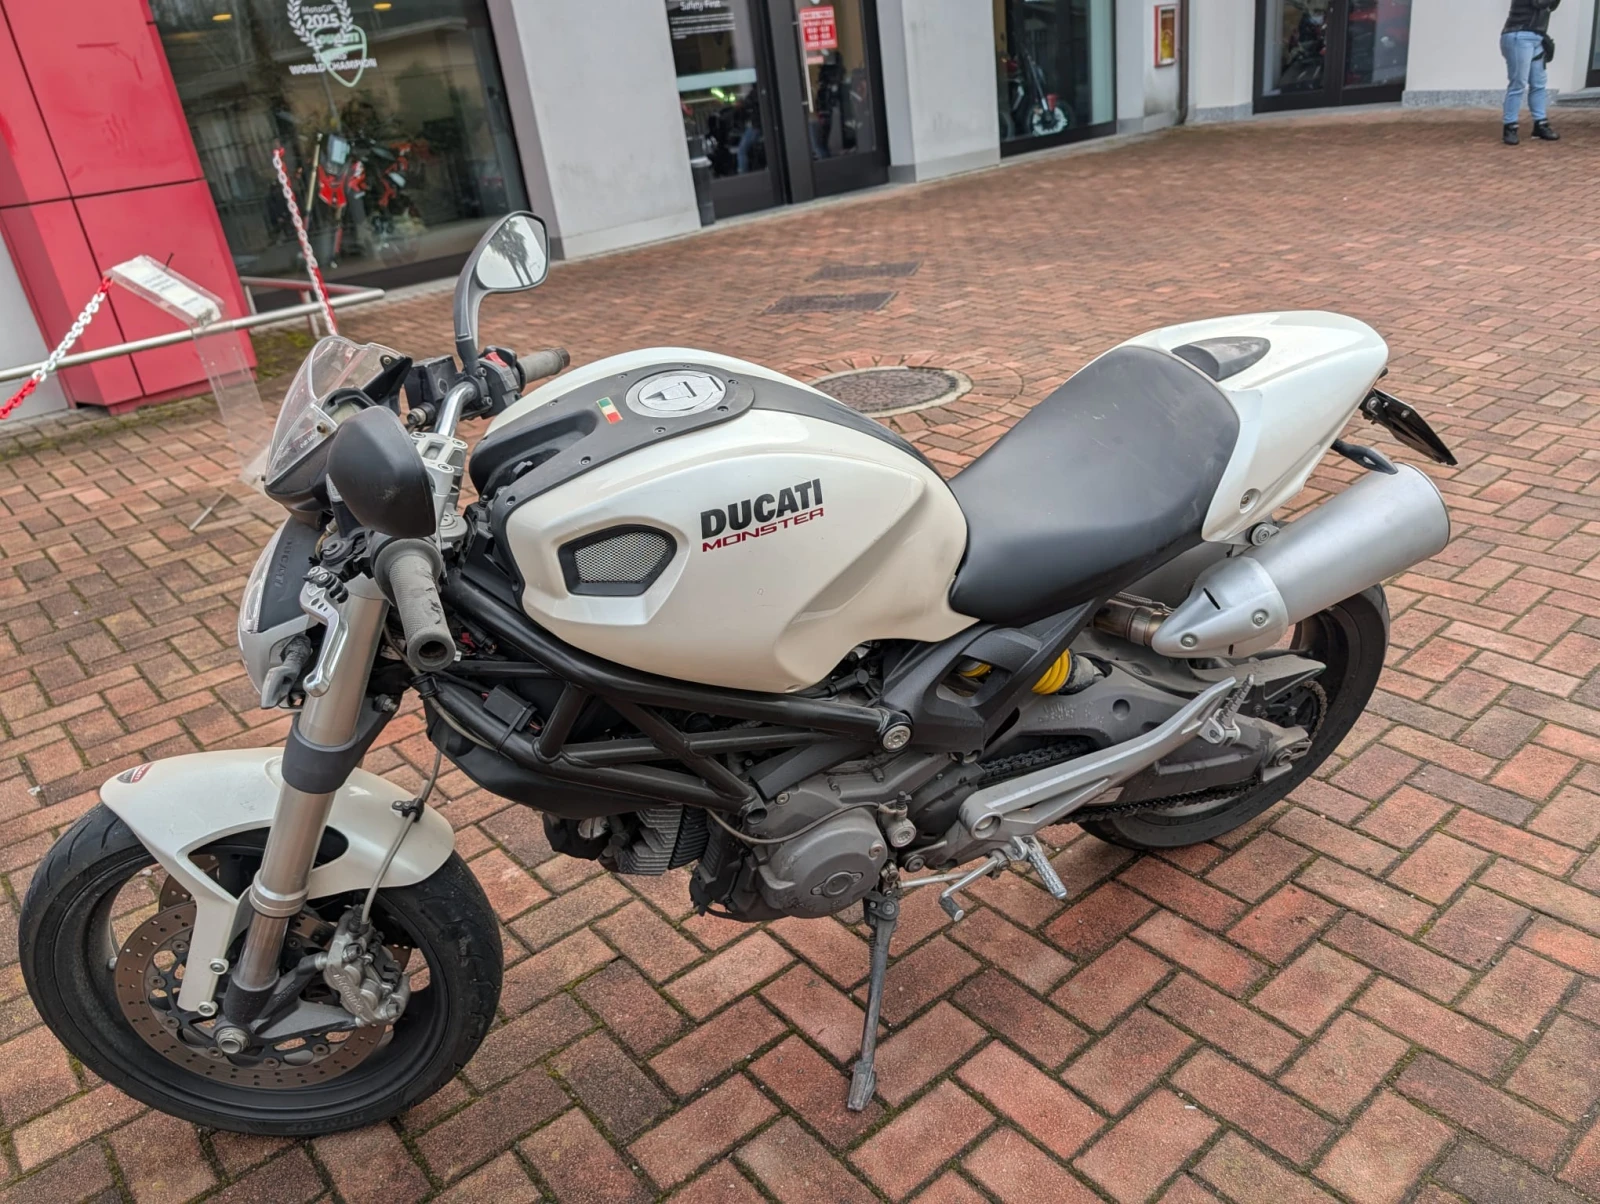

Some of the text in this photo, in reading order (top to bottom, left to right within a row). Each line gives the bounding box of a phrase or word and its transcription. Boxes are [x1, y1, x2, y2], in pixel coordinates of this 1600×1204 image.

[303, 13, 340, 29] 2025
[289, 62, 327, 75] WORLD
[700, 478, 823, 540] DUCATI
[702, 507, 825, 553] MONSTER
